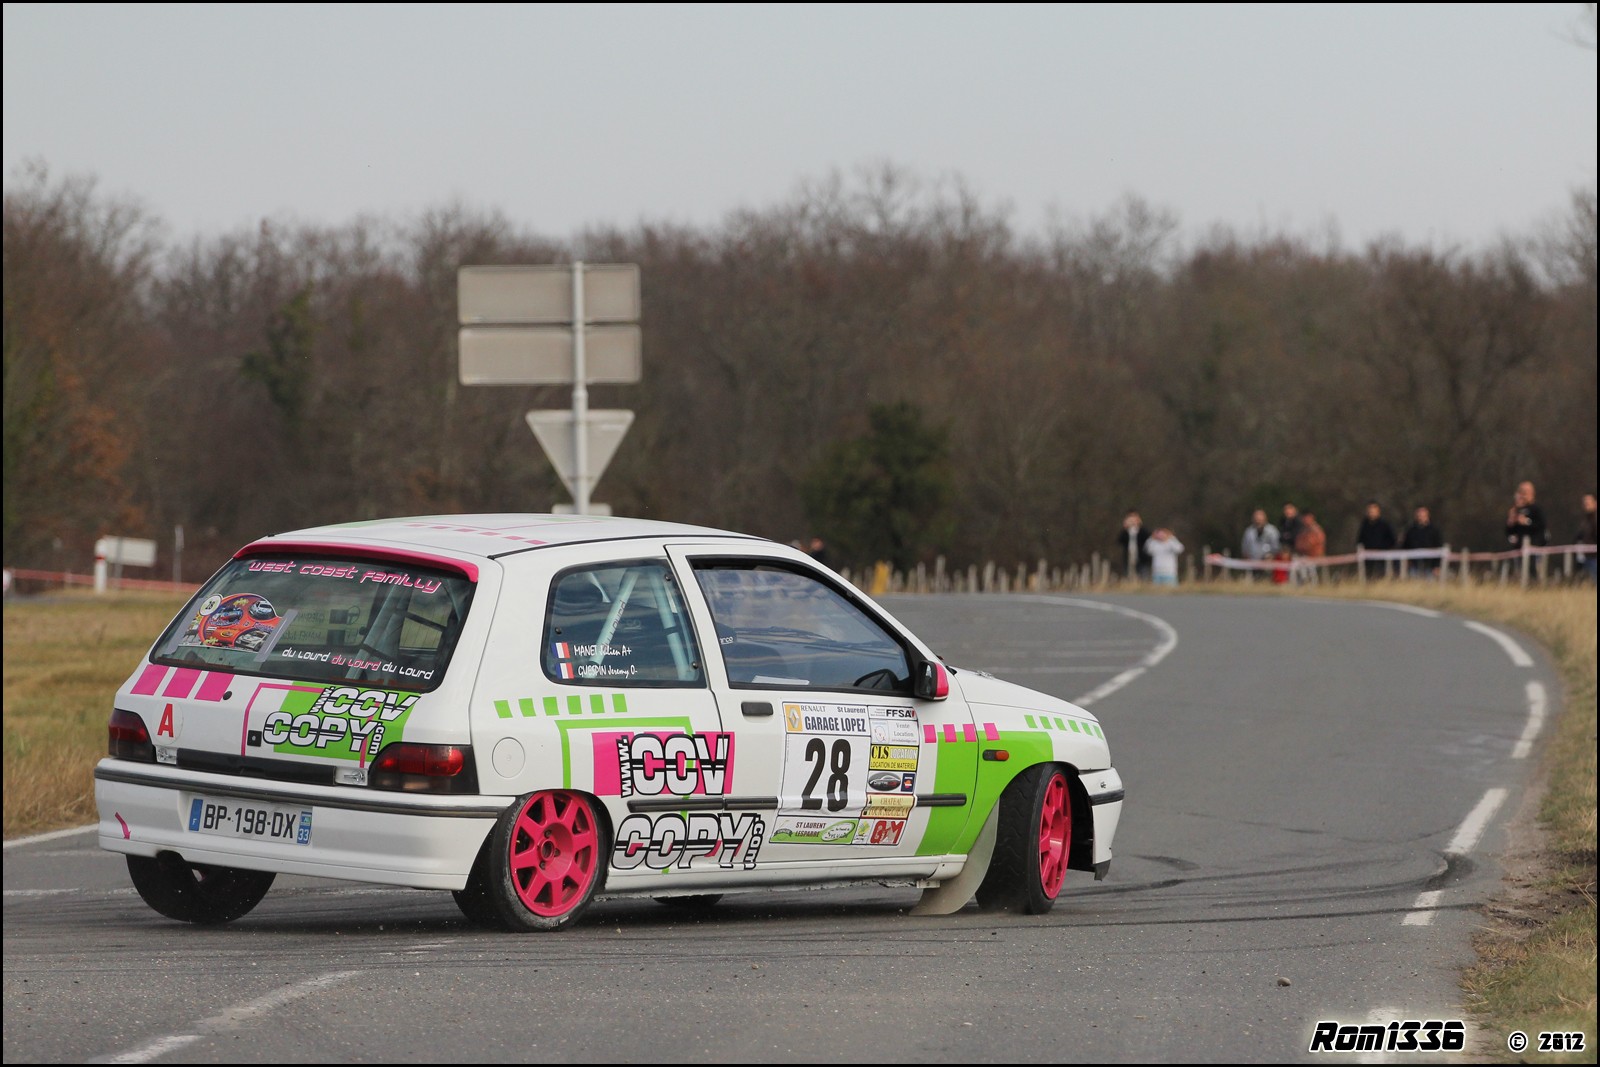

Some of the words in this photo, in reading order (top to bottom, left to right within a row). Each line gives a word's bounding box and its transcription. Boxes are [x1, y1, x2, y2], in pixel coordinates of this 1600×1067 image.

[573, 644, 598, 657] MANET
[281, 646, 297, 658] du
[381, 661, 398, 673] du
[608, 665, 630, 679] Jeremy
[321, 687, 421, 722] CCV
[800, 704, 826, 713] RENAULT
[844, 706, 866, 714] Laurent
[157, 703, 174, 738] A
[886, 709, 912, 718] FFSA
[804, 716, 840, 732] GARAGE
[840, 717, 866, 732] LOPEZ
[262, 711, 378, 753] COPY
[871, 745, 890, 760] CLS
[890, 747, 918, 760] LOCATION
[630, 733, 731, 796] CCV
[870, 760, 891, 769] LOCATION
[890, 761, 897, 769] DE
[896, 761, 916, 770] MATERIEL
[801, 737, 852, 812] 28
[795, 821, 803, 829] ST
[803, 821, 827, 830] LAURENT
[297, 828, 310, 841] 33
[611, 813, 758, 870] COPY
[795, 830, 820, 838] LESPARRE
